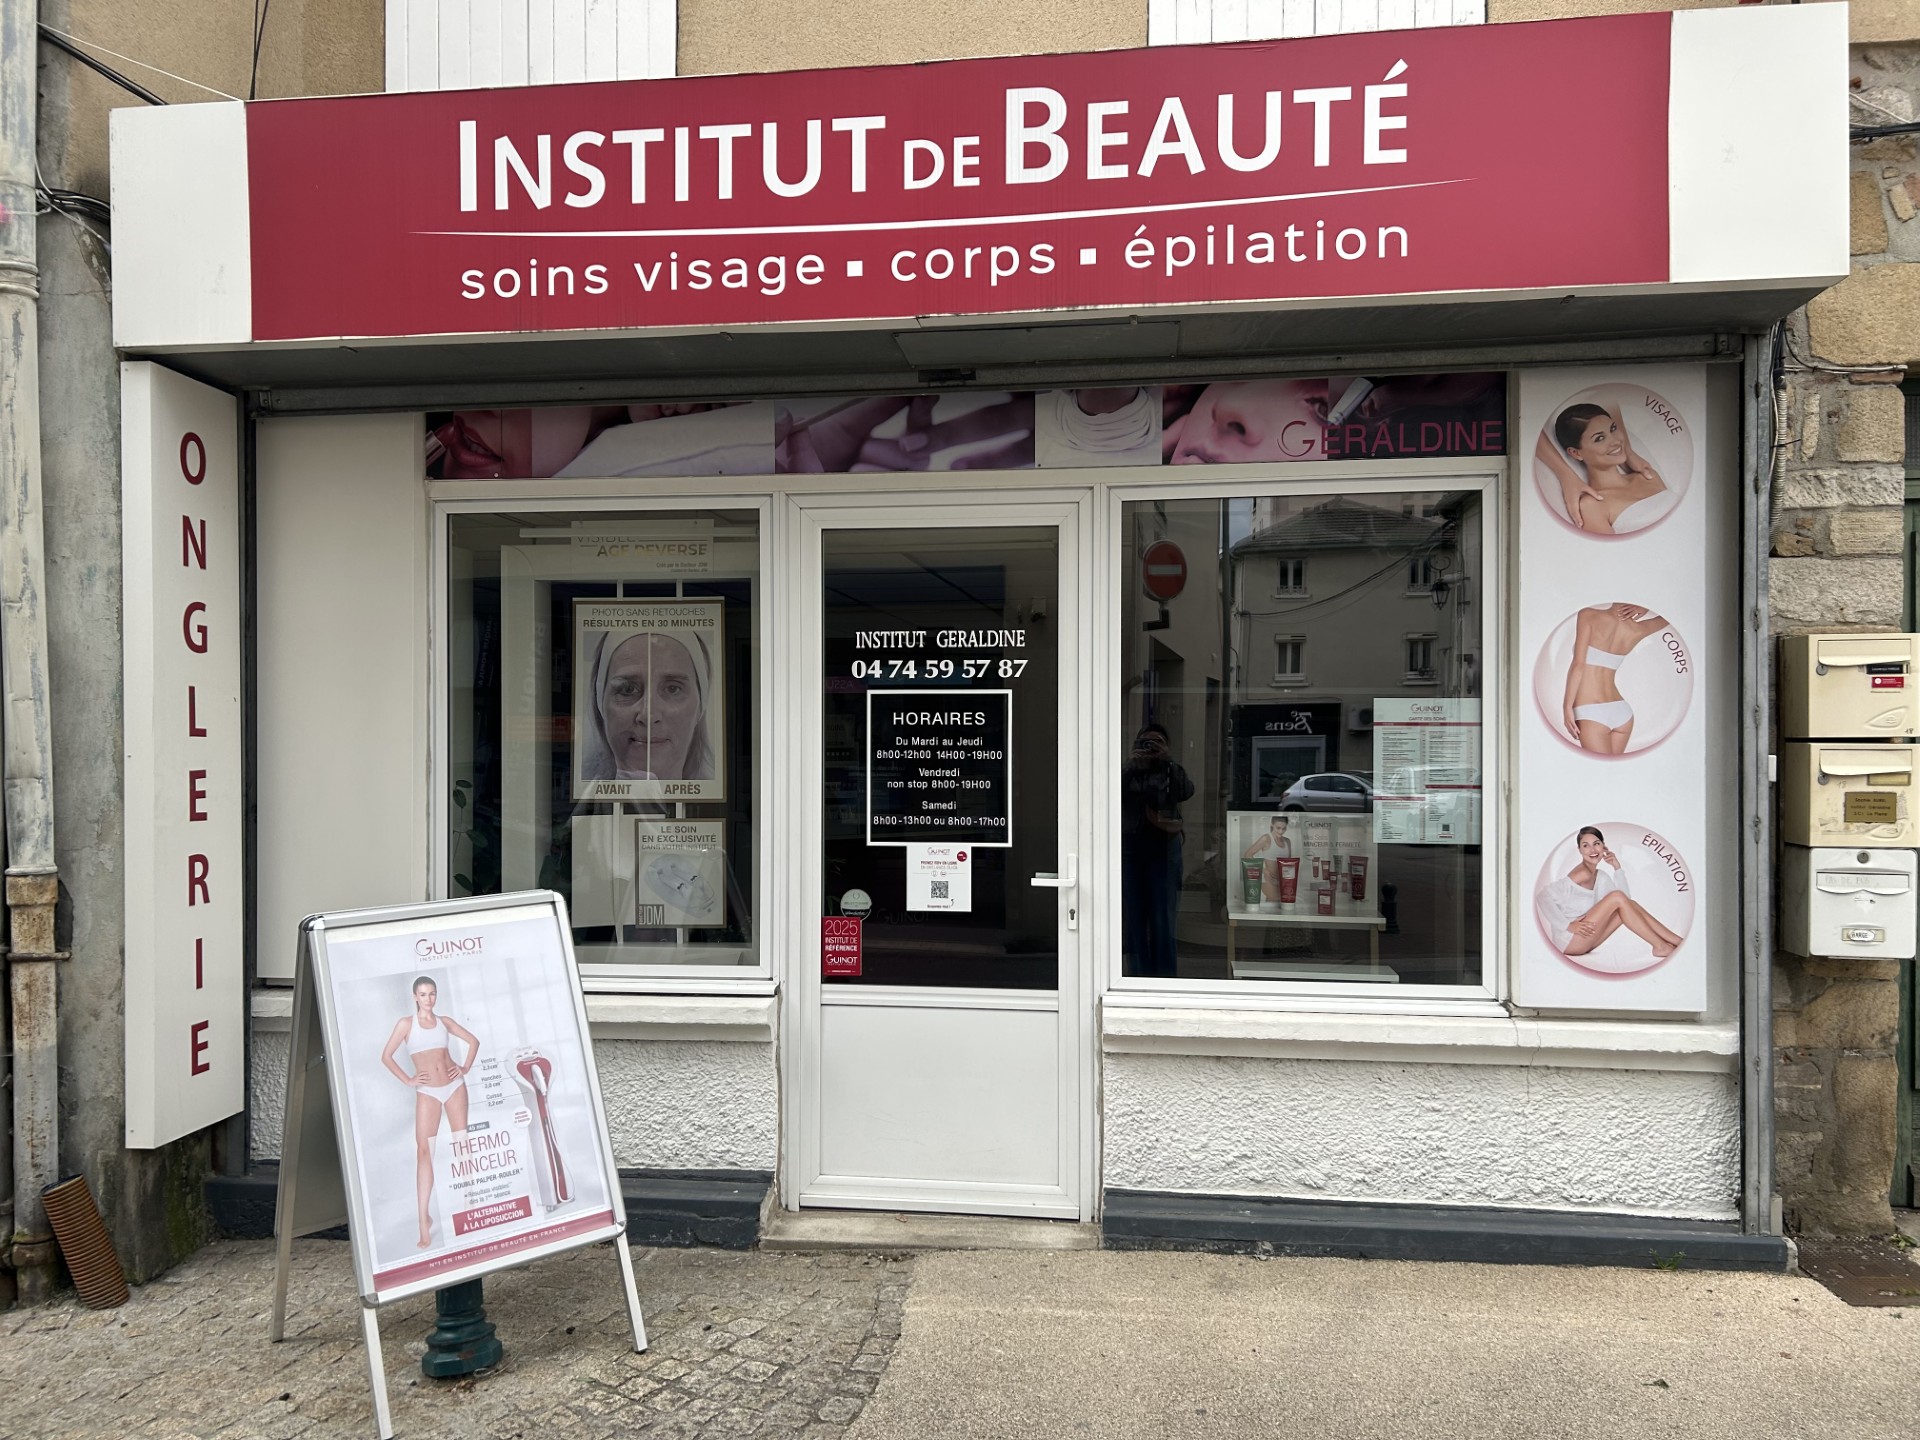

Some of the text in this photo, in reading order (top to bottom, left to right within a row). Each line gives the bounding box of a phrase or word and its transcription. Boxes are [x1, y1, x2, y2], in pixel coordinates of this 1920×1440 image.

[459, 58, 1409, 212] INSTITUT DE BEAUTÉ
[460, 219, 1409, 300] soins visage corps épilation
[1644, 395, 1683, 435] VISAGE
[1276, 420, 1503, 457] GERALDINE
[592, 608, 706, 616] PHOTO SANS RETOUCHES
[583, 618, 638, 627] RÉSULTATS
[658, 619, 668, 627] 30
[671, 619, 714, 627] MINUTES
[855, 630, 1026, 649] INSTITUT GERALDINE
[1662, 632, 1688, 674] CORPS
[851, 659, 1029, 679] 04 74 59 57 87
[893, 712, 986, 726] HORAIRES
[896, 737, 908, 746] Du
[912, 736, 939, 746] Mardi
[957, 736, 983, 746] Jeudi
[179, 431, 211, 1077] ONGLERIE
[876, 750, 931, 759] 8h00-12h00
[918, 768, 960, 777] Vendredi
[595, 782, 701, 794] AVANT APRÈS
[908, 780, 928, 790] stop
[922, 801, 957, 810] Samedi
[657, 834, 716, 842] EXCLUSIVITÉ
[660, 826, 697, 834] LE SOIN
[1641, 834, 1689, 892] ÉPILATION
[644, 905, 664, 925] JDM
[825, 920, 858, 936] 2025
[415, 936, 484, 957] GUINOT
[825, 944, 858, 952] RÉFÉRENCE
[826, 954, 858, 964] GUINOT
[449, 1130, 511, 1158] THERMO
[451, 1150, 517, 1179] MINCEUR
[463, 1209, 524, 1231] À LA LIPOSUCCION
[467, 1201, 518, 1220] L'ALTERNATIVE
[455, 1248, 487, 1261] INSTITUT
[540, 1226, 567, 1238] FRANCE
